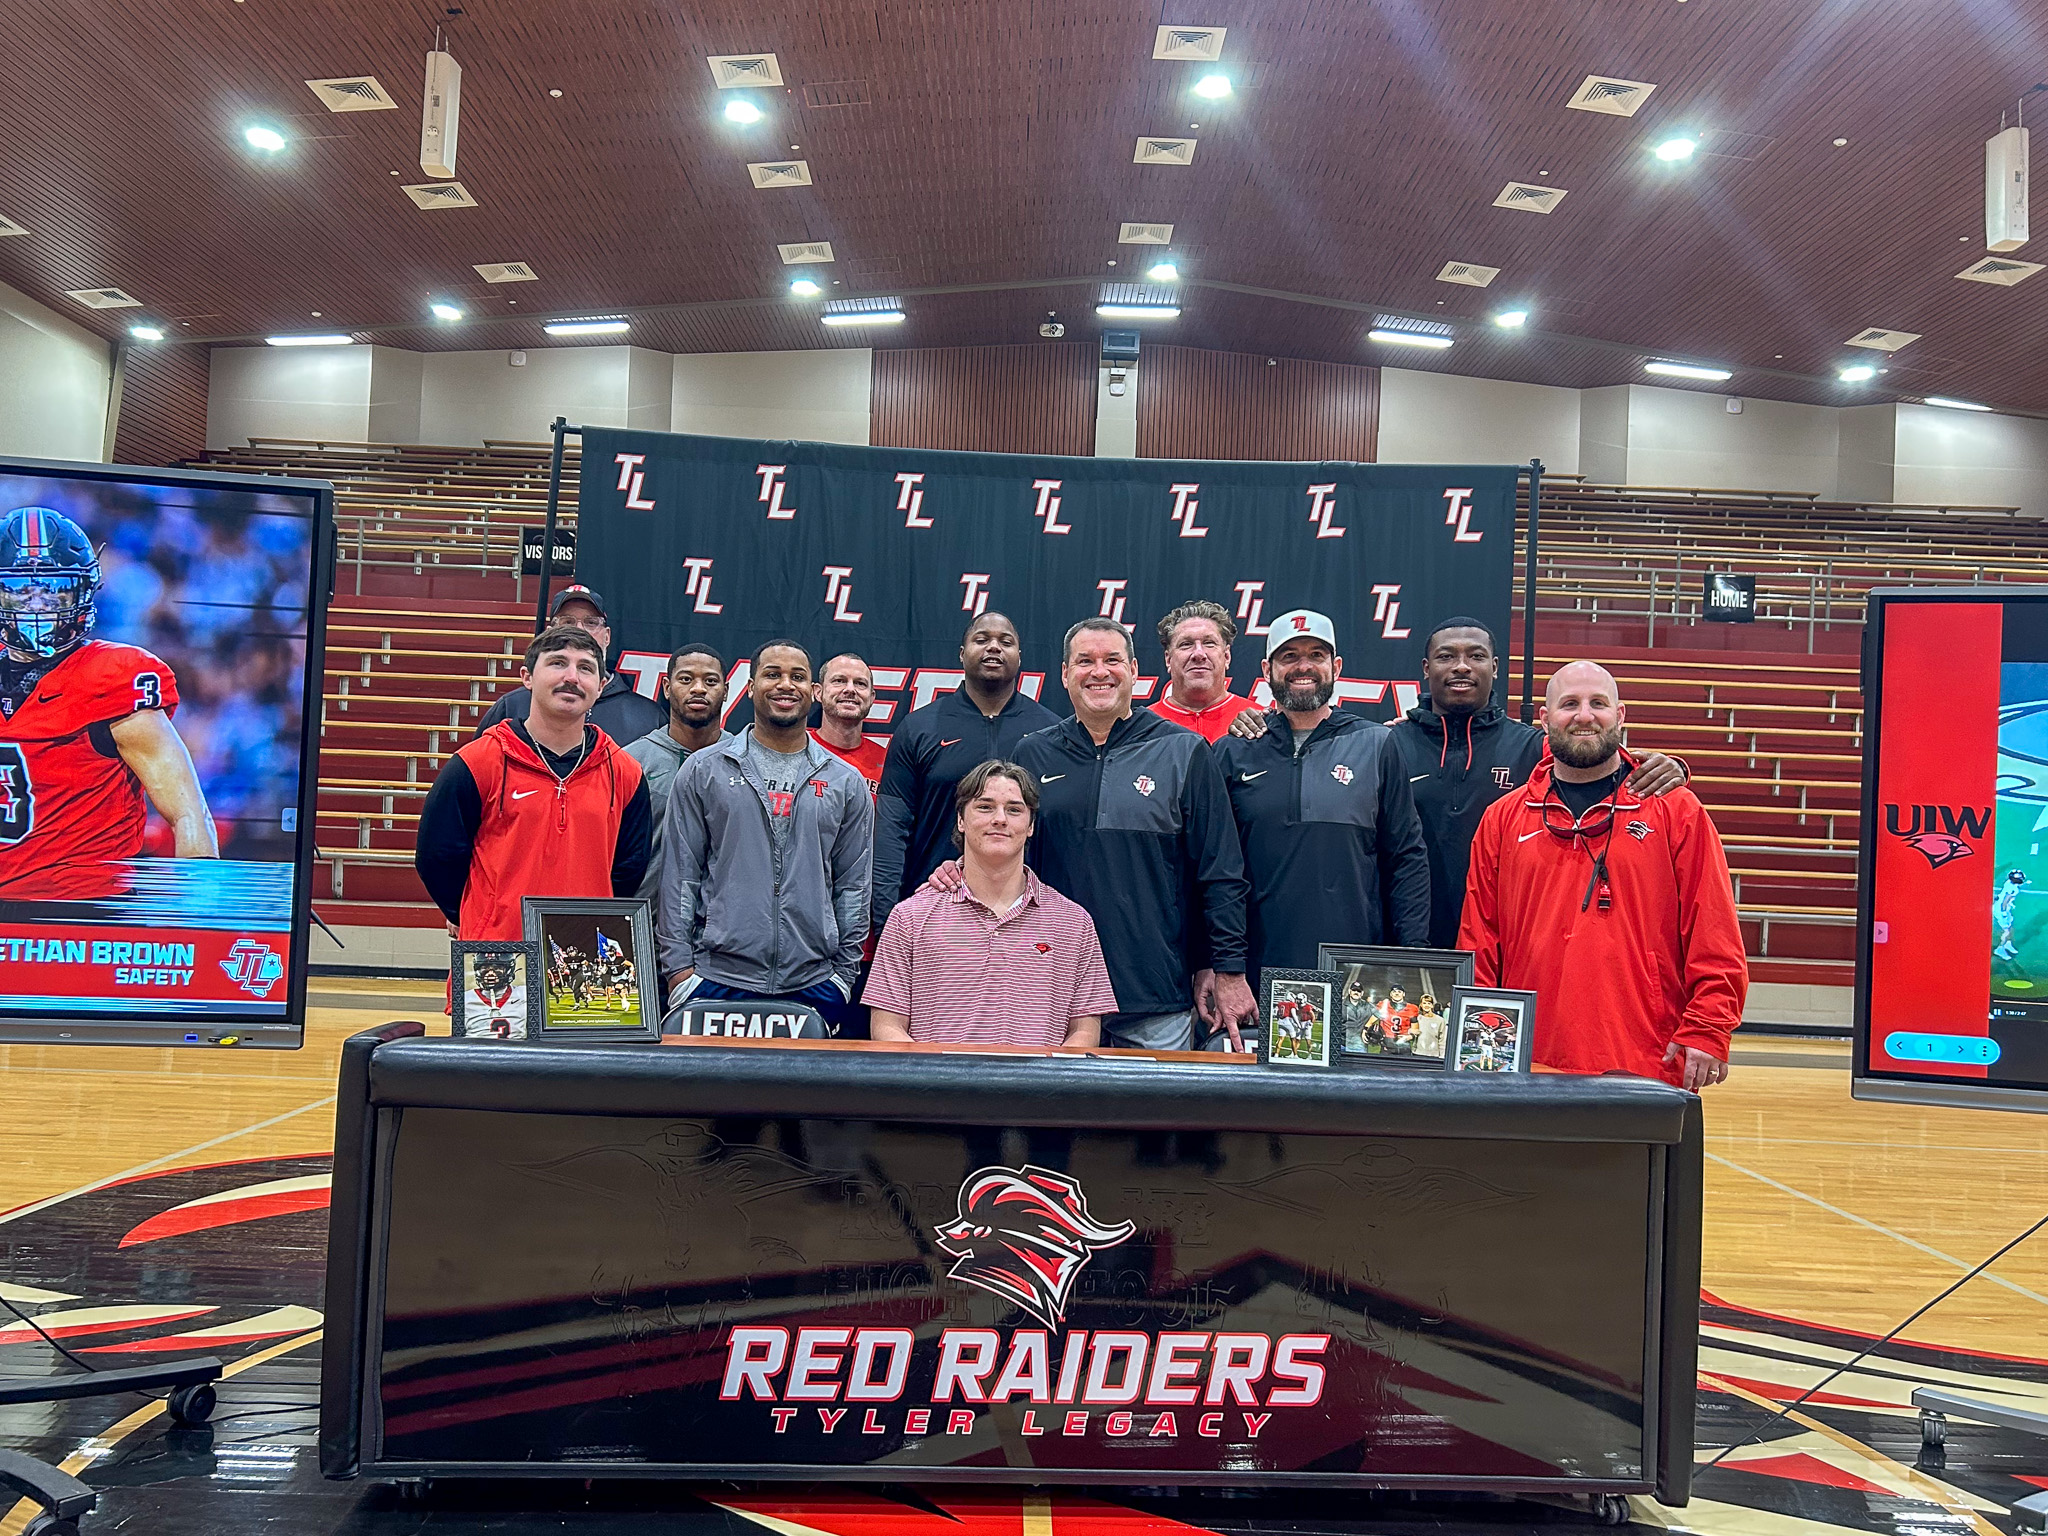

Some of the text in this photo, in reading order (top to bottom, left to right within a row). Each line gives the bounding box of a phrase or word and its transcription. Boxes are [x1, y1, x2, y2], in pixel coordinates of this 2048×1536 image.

[614, 453, 656, 511] TL
[755, 464, 796, 519] TL
[894, 472, 934, 528] TL
[1032, 479, 1072, 534] TL
[1169, 483, 1209, 538] TL
[1306, 482, 1346, 539] TL
[1443, 487, 1484, 542] TL
[525, 544, 573, 560] VISORS
[682, 557, 724, 615] TL
[821, 565, 863, 623] TL
[1097, 579, 1136, 633] TL
[1234, 581, 1271, 636] TL
[1710, 589, 1748, 608] HOME
[1290, 616, 1311, 632] TL
[1371, 584, 1411, 639] TL
[134, 672, 161, 710] 3
[809, 778, 828, 798] T
[1491, 767, 1514, 790] TL
[1884, 803, 1992, 840] UIW
[91, 940, 195, 967] BROWN
[115, 967, 194, 986] SAFETY
[232, 944, 273, 991] TL
[681, 1010, 809, 1040] LEGACY
[1391, 1017, 1402, 1034] 3
[1927, 1043, 1932, 1052] 1
[718, 1325, 1332, 1406] RED RAIDERS
[770, 1407, 1273, 1438] TYLER LEGACY
